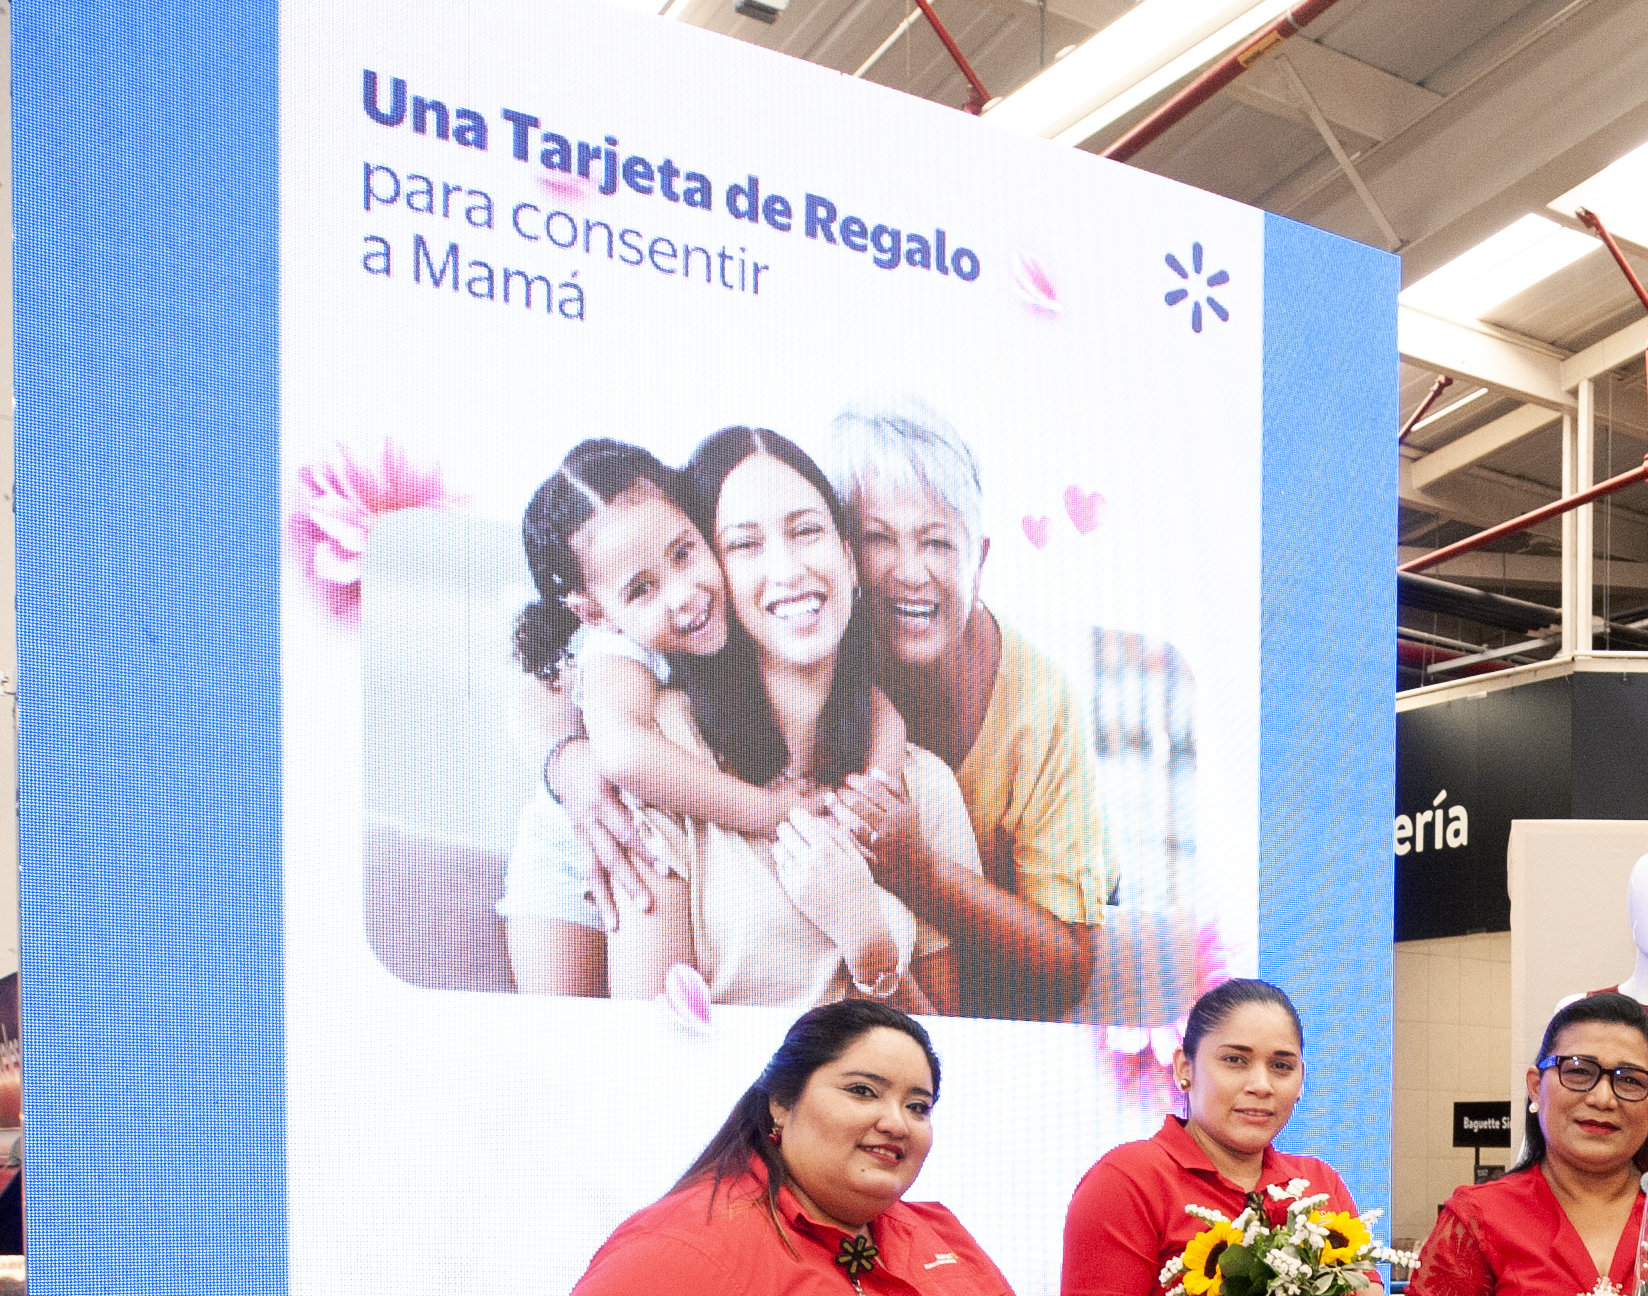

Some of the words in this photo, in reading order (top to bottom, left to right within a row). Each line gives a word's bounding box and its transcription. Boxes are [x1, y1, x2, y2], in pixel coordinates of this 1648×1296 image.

[361, 68, 490, 151] Una
[500, 107, 713, 213] Tarjeta
[724, 173, 794, 233] de
[803, 194, 982, 283] Regalo
[361, 159, 495, 231] para
[512, 199, 770, 297] consentir
[362, 234, 393, 277] a
[413, 233, 587, 323] Mamá
[1395, 789, 1468, 856] ería
[1463, 1116, 1500, 1133] Baguette
[1502, 1116, 1511, 1130] Si
